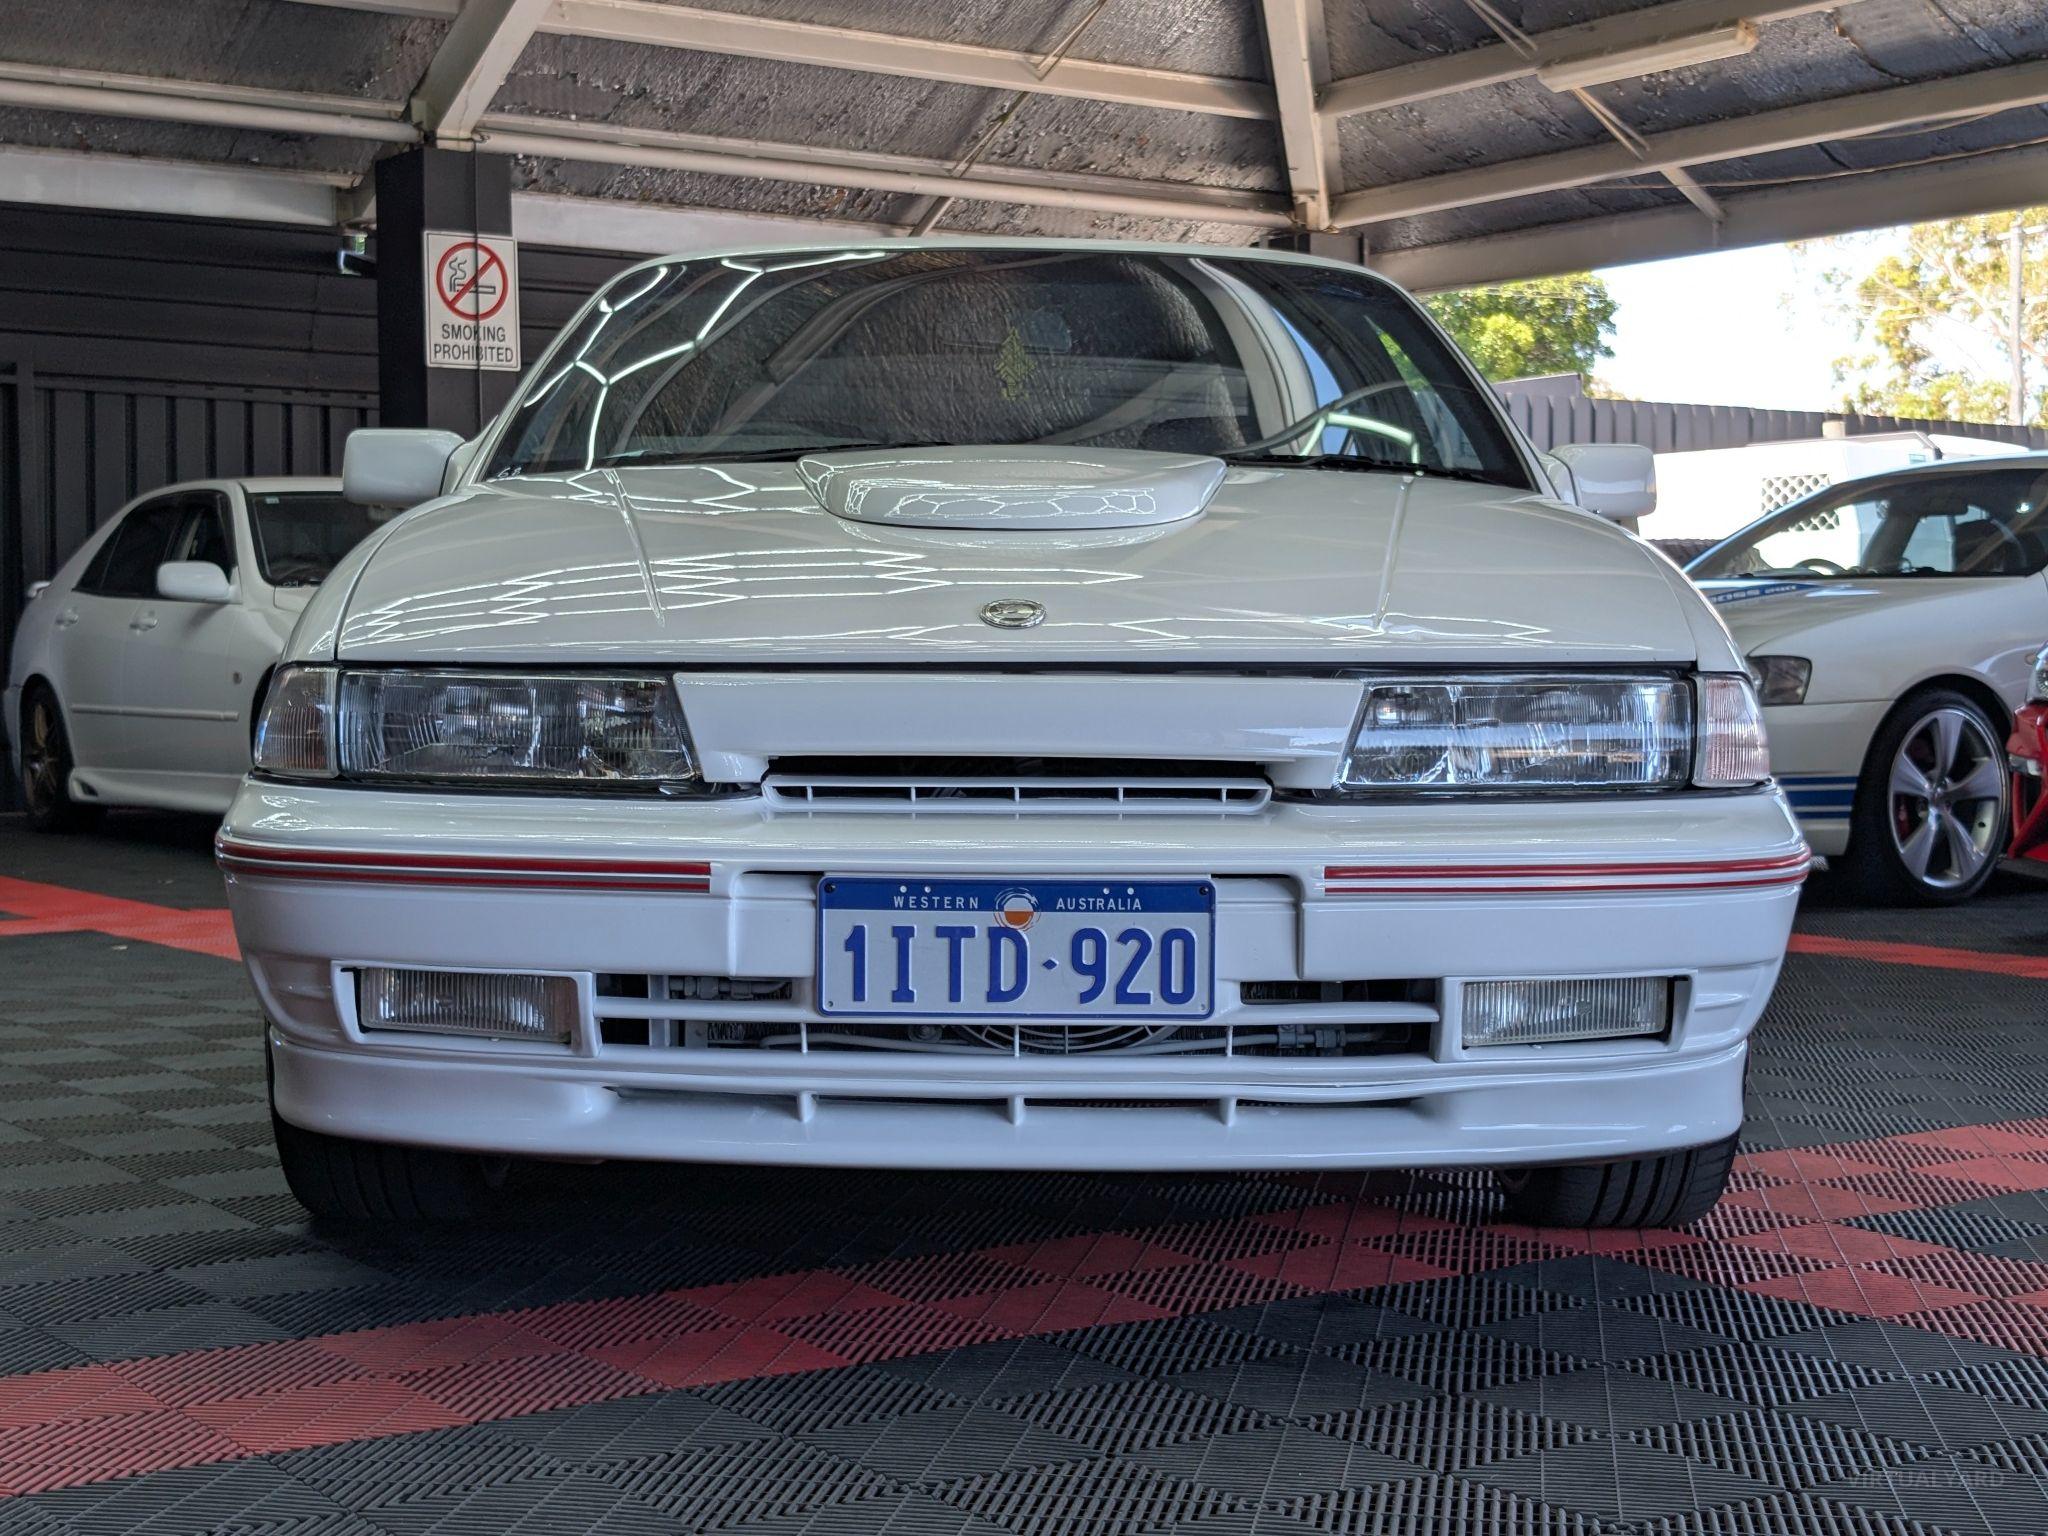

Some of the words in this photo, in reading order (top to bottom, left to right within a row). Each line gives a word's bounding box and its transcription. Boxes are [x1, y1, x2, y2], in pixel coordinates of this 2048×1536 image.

[441, 323, 506, 342] SMOKING
[433, 343, 514, 362] PROHIBITED
[893, 896, 979, 909] WESTERN
[1056, 897, 1142, 910] AUSTRALIA
